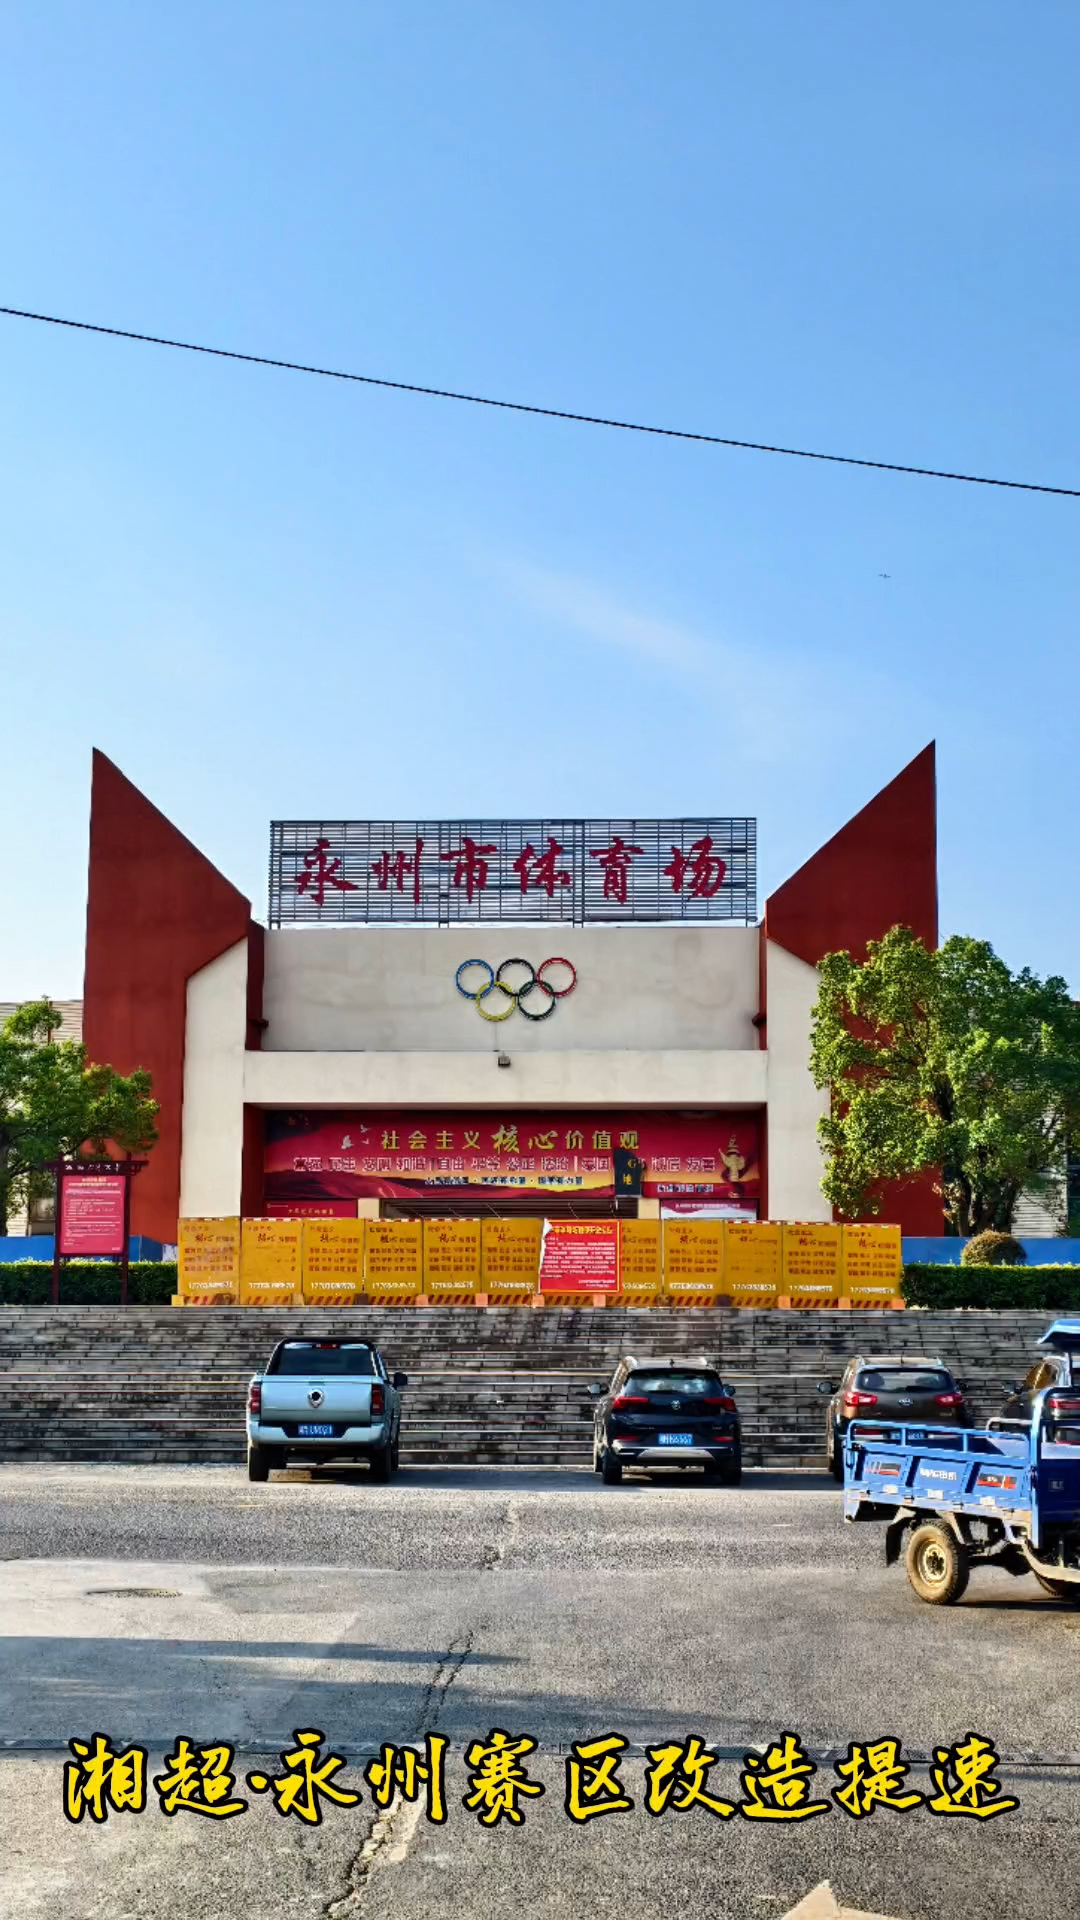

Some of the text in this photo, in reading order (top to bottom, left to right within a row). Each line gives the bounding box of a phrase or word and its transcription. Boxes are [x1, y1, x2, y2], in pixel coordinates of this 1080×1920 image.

[295, 836, 727, 904] 永州市体育场
[382, 1124, 639, 1153] 社会主义核心价值观
